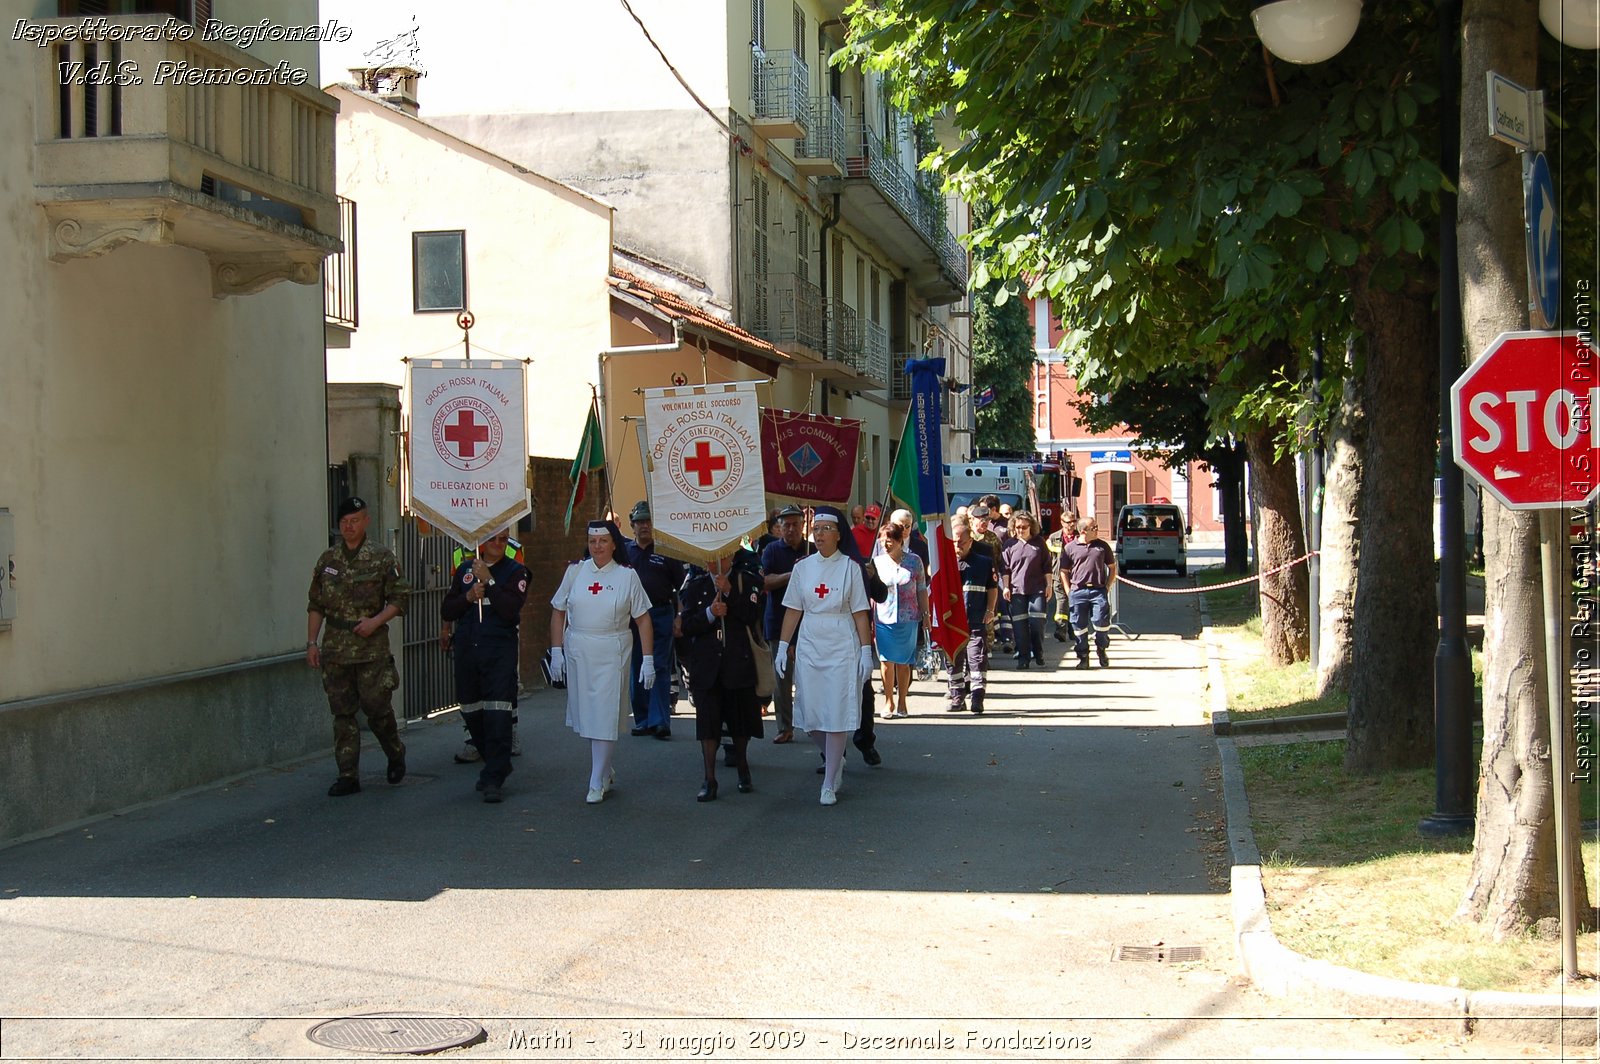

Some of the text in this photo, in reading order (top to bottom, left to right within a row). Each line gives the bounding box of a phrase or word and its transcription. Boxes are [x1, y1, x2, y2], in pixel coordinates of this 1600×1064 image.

[425, 376, 509, 407] CROCE ROSSA ITALIANA
[452, 399, 482, 410] GINEVRA
[482, 406, 492, 416] 22
[662, 398, 741, 412] VOLONTARI DEL SOCCORSO
[653, 410, 757, 460] CROCE ROSSA ITALIANA
[800, 426, 848, 458] COMUNALE
[679, 435, 688, 445] DI
[725, 439, 737, 450] 22
[430, 481, 509, 490] DELEGAZIONE DI
[786, 482, 817, 493] MATHI
[451, 498, 488, 508] MATHI
[669, 507, 750, 521] COMITATO LOCALE
[692, 521, 728, 533] FIANO
